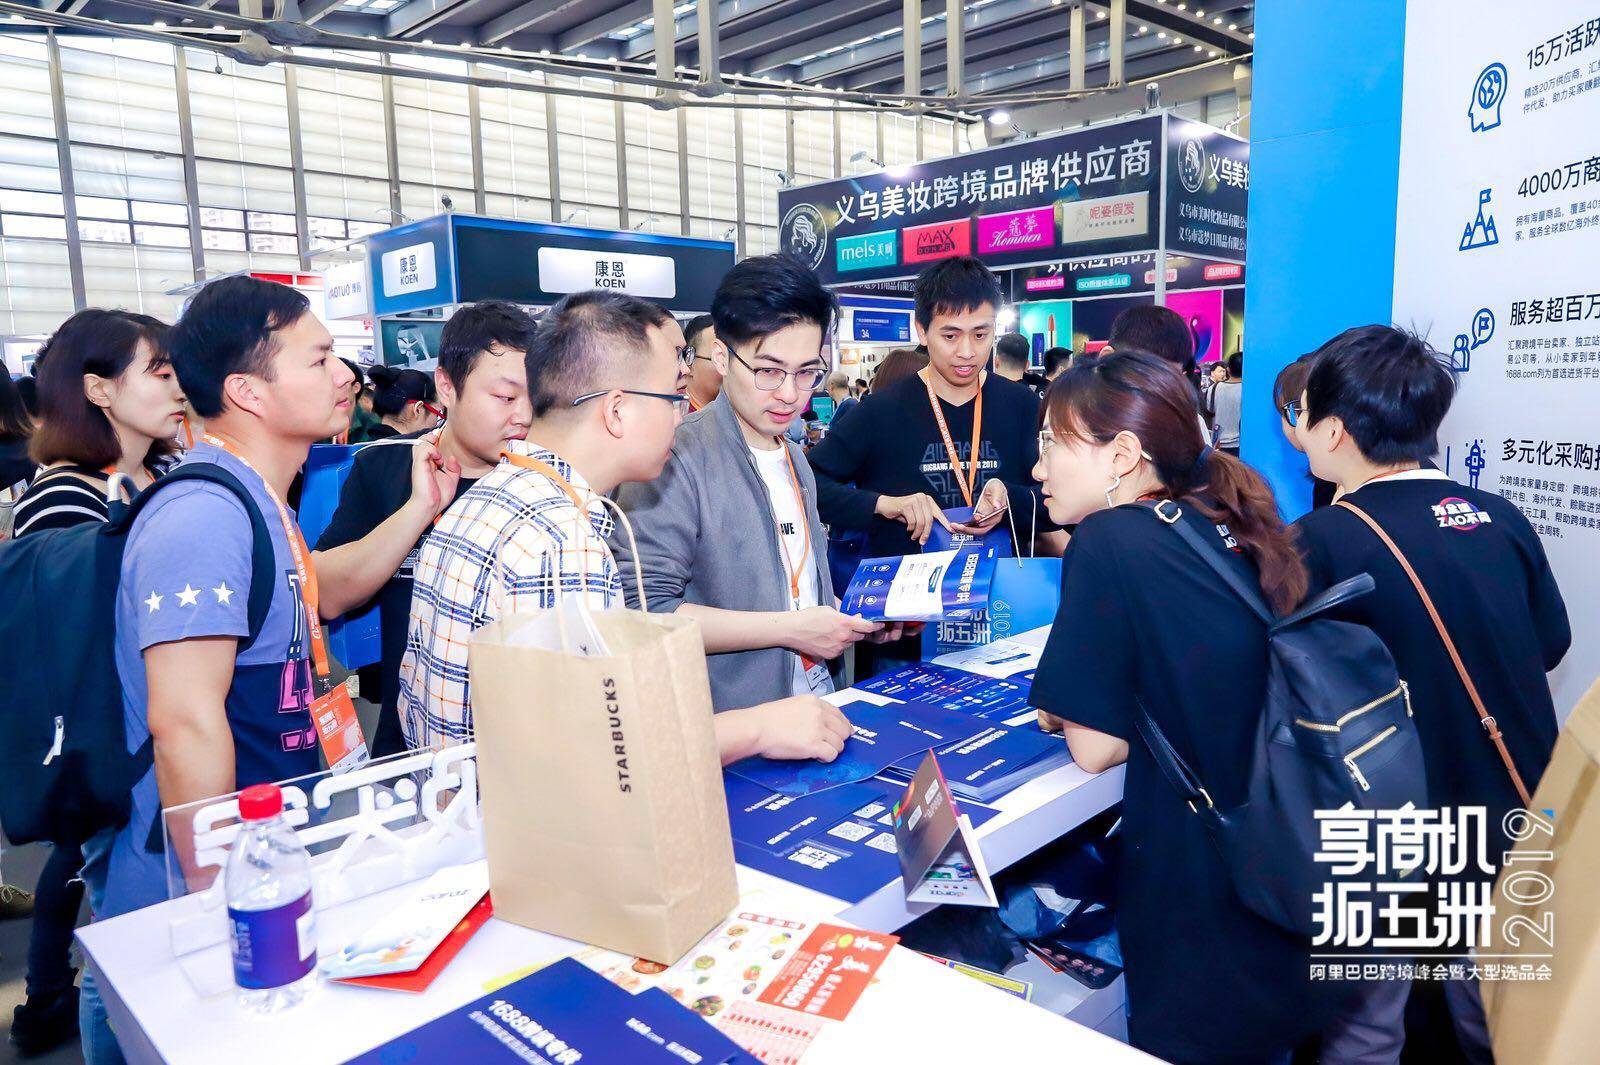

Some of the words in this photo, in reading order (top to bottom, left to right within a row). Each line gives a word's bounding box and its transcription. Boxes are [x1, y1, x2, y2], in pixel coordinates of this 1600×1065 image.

[834, 139, 1152, 227] 义乌美妆跨境品牌供应商
[1517, 155, 1600, 198] 4000万商
[917, 226, 956, 250] MAX
[400, 254, 417, 274] 康恩
[595, 260, 625, 277] 康恩
[400, 273, 418, 286] KOEN
[595, 278, 626, 288] KOEN
[1509, 294, 1600, 326] 服务超百万
[603, 678, 632, 793] STARBUCKS
